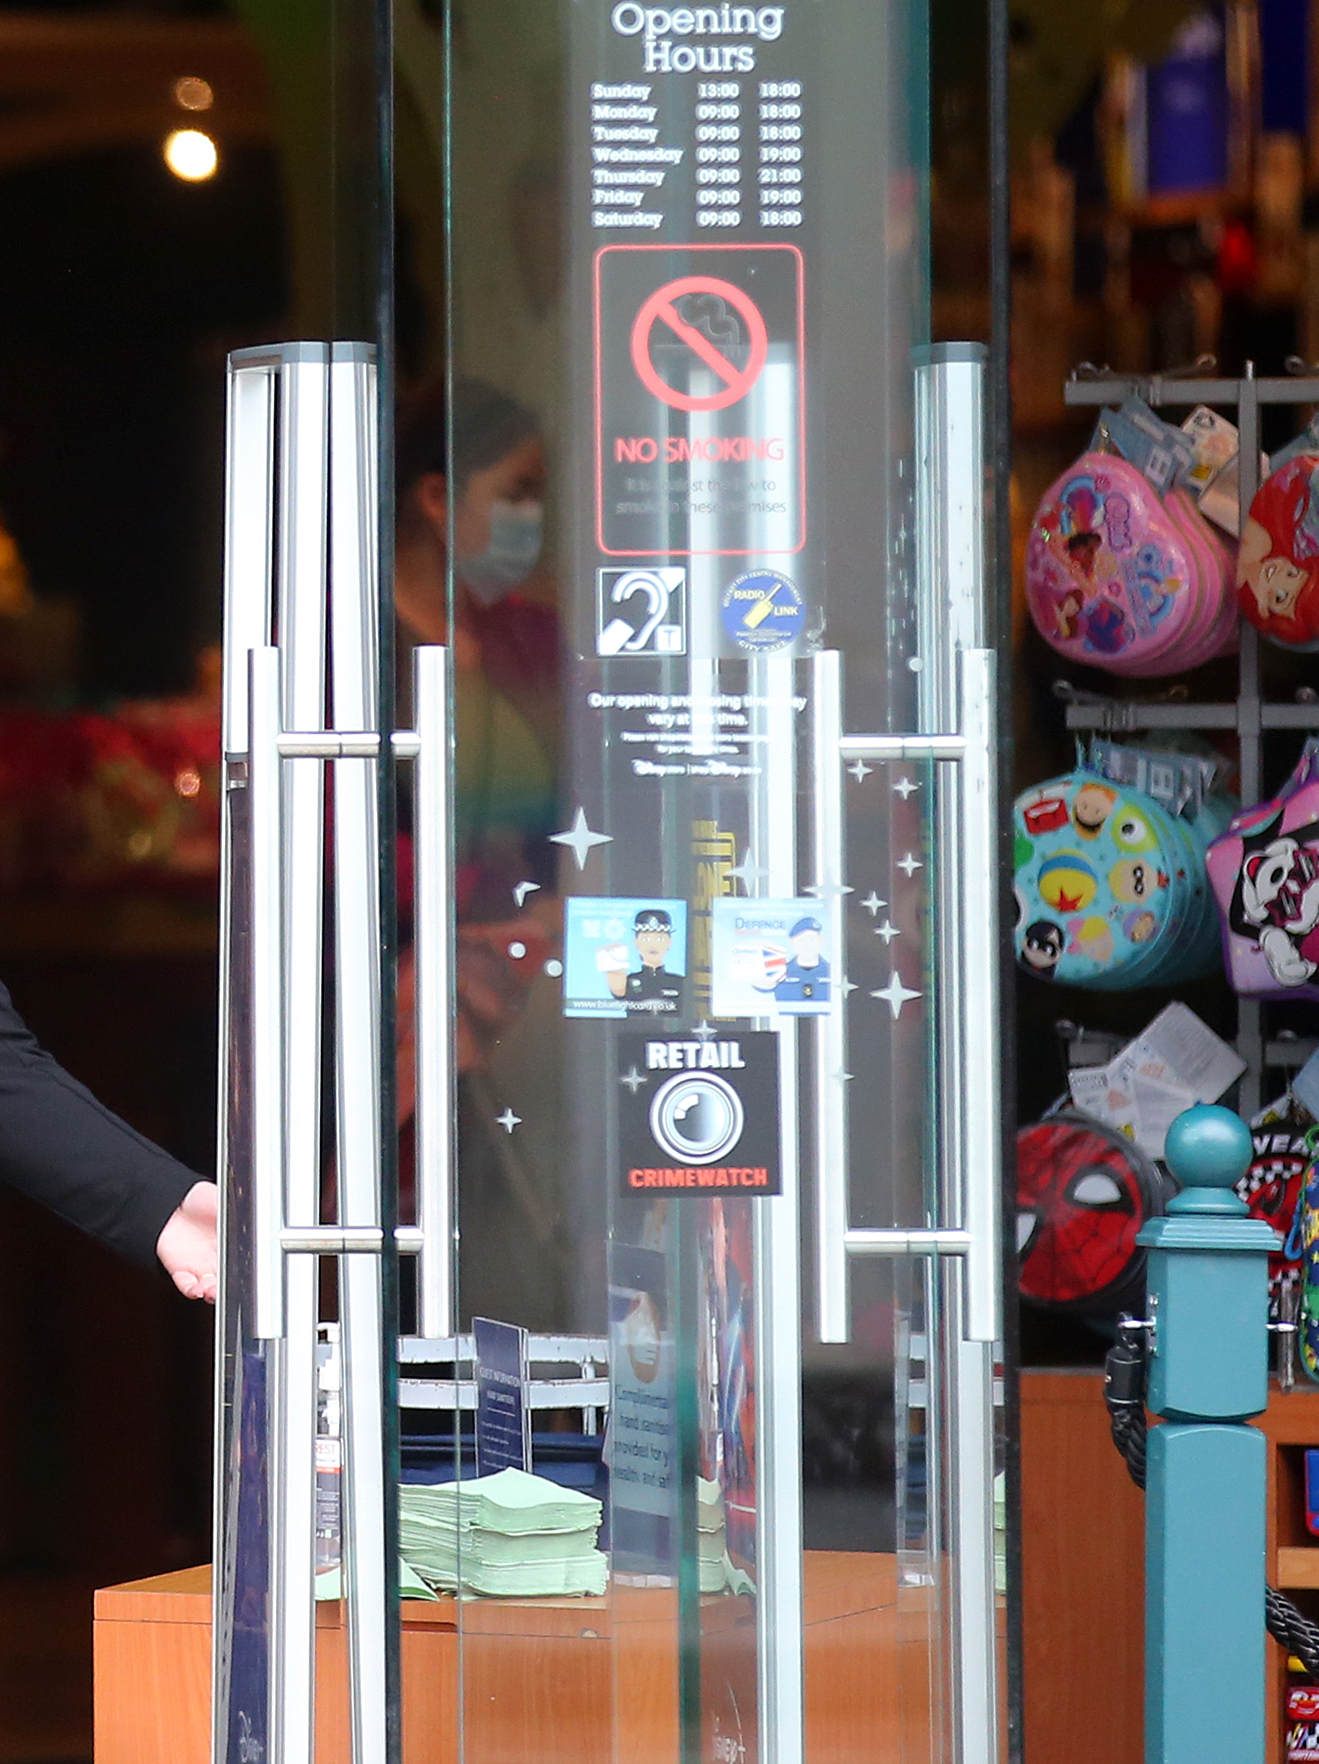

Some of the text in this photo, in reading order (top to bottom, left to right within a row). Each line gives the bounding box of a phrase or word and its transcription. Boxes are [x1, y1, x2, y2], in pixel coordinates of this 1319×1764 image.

[613, 1, 784, 40] Opening
[643, 41, 755, 73] Hours
[592, 83, 803, 100] Sunday 13:00 18:00
[592, 104, 803, 122] Monday 09:00 18:00
[592, 125, 803, 143] Tuesday 09:00 18:00
[592, 147, 803, 164] Wednesday 09:00 19:00
[592, 168, 803, 187] Thursday 09:00 21:00
[592, 190, 803, 206] Friday 09:00 19:00
[592, 211, 803, 229] Saturday 09:00 18:00
[615, 437, 785, 463] NO SMOKING
[762, 480, 777, 491] to
[685, 499, 720, 513] hese
[734, 589, 766, 600] RADIO
[774, 605, 799, 617] LINK
[588, 693, 615, 708] Our
[617, 694, 668, 711] opening
[647, 713, 675, 728] vary
[676, 713, 690, 725] at
[645, 1041, 746, 1069] RETAIL
[628, 1167, 769, 1188] CRIMEWATCH
